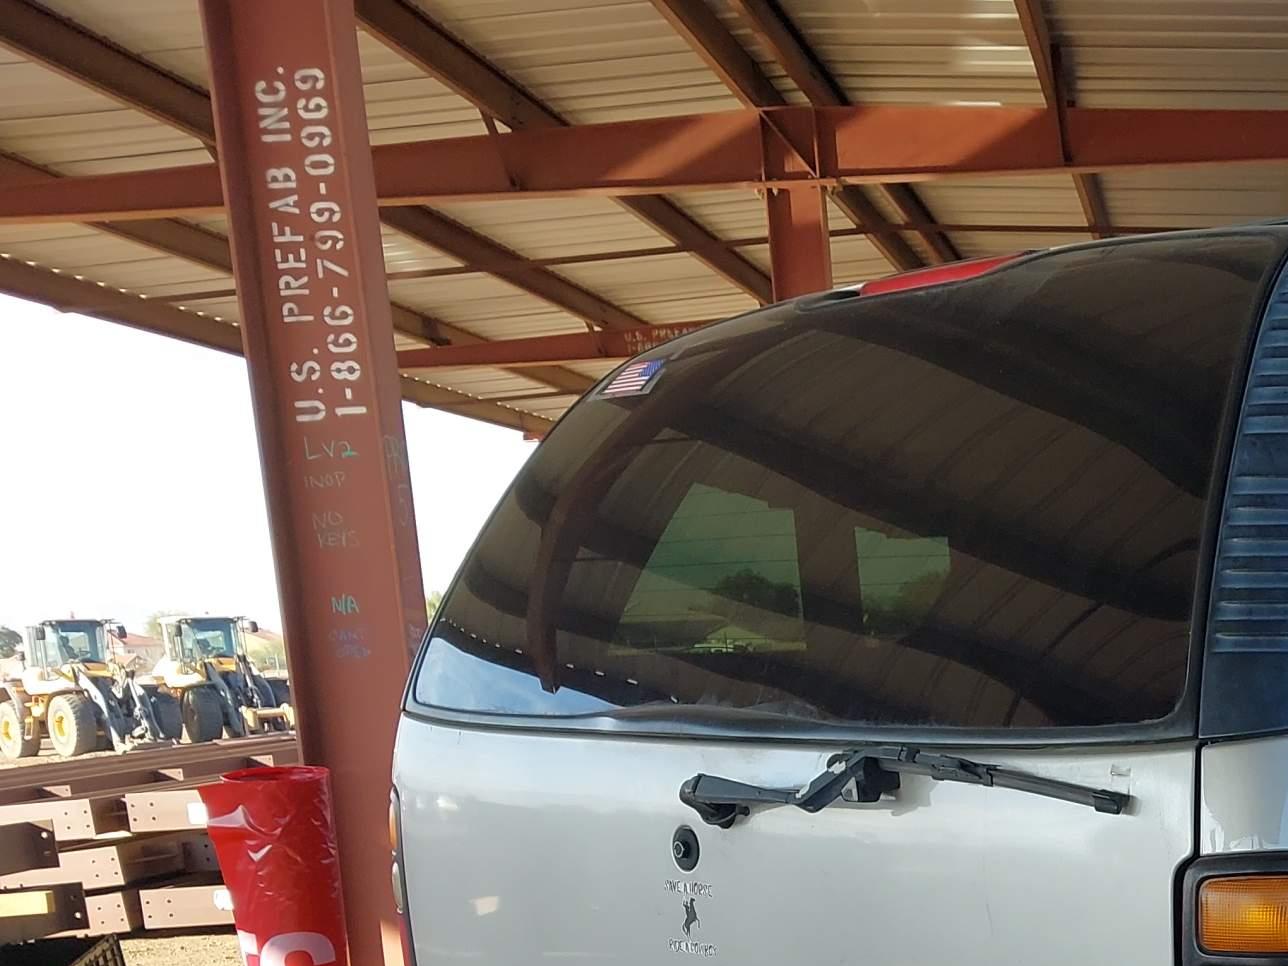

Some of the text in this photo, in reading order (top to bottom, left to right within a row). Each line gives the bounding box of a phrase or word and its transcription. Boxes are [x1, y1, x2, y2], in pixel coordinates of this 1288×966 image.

[255, 66, 326, 422] U.S. PREFAB INC.
[294, 68, 367, 417] 1-866-799-0969
[312, 511, 343, 530] NO
[664, 880, 681, 893] SAVE
